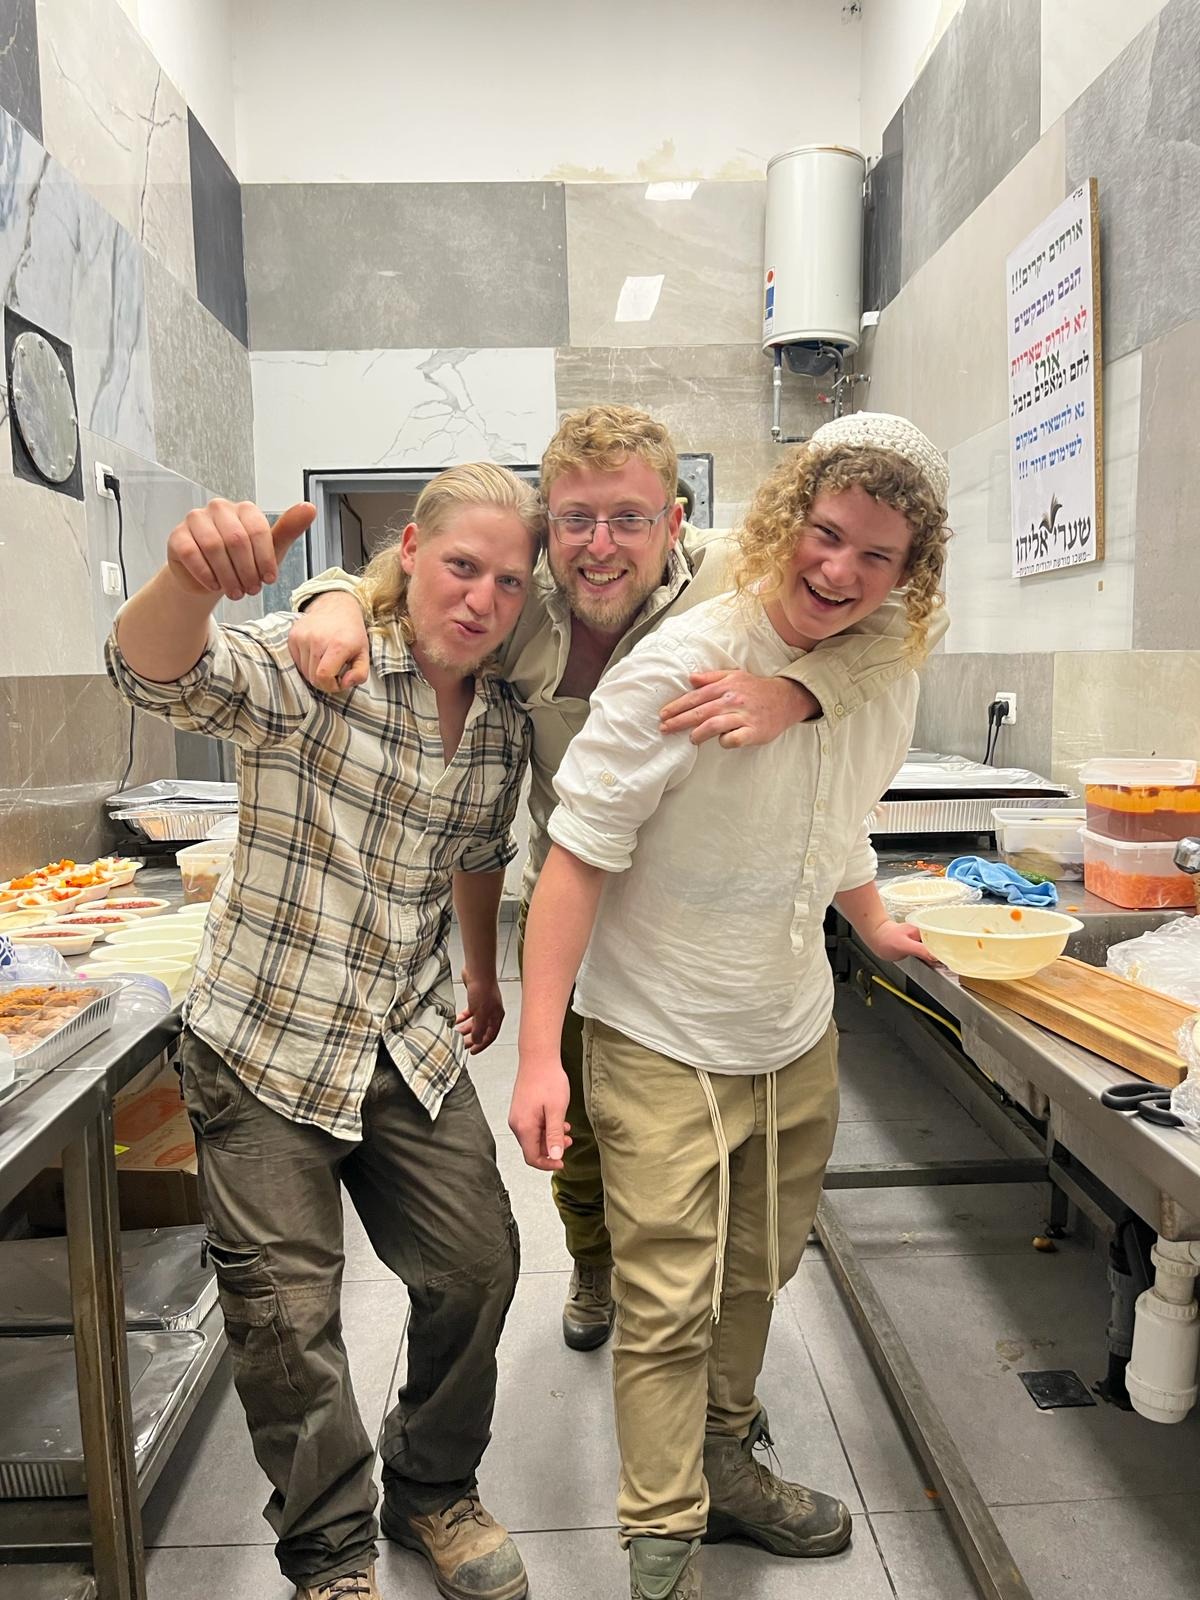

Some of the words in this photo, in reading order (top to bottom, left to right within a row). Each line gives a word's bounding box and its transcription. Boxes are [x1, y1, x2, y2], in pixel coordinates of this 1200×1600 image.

[1049, 218, 1083, 263] אורחים
[1012, 250, 1046, 295] יקרים!!!
[1057, 266, 1081, 300] הנכם
[1014, 289, 1054, 334] מתבקשים
[1074, 304, 1087, 334] לא
[1045, 316, 1070, 355] לזרוק
[1011, 340, 1042, 377] שאריות
[1035, 349, 1060, 383] אורז
[1070, 349, 1089, 382] לחם
[1035, 368, 1066, 403] ומאפים
[1011, 391, 1031, 417] בזבל.
[1040, 403, 1072, 436] להשאיר
[1074, 400, 1085, 421] נא
[1015, 427, 1038, 451] במקום
[1049, 433, 1082, 467] לשימוש
[1030, 455, 1047, 474] חוזר
[1016, 523, 1048, 565] אליהו
[1054, 516, 1091, 554] שערי
